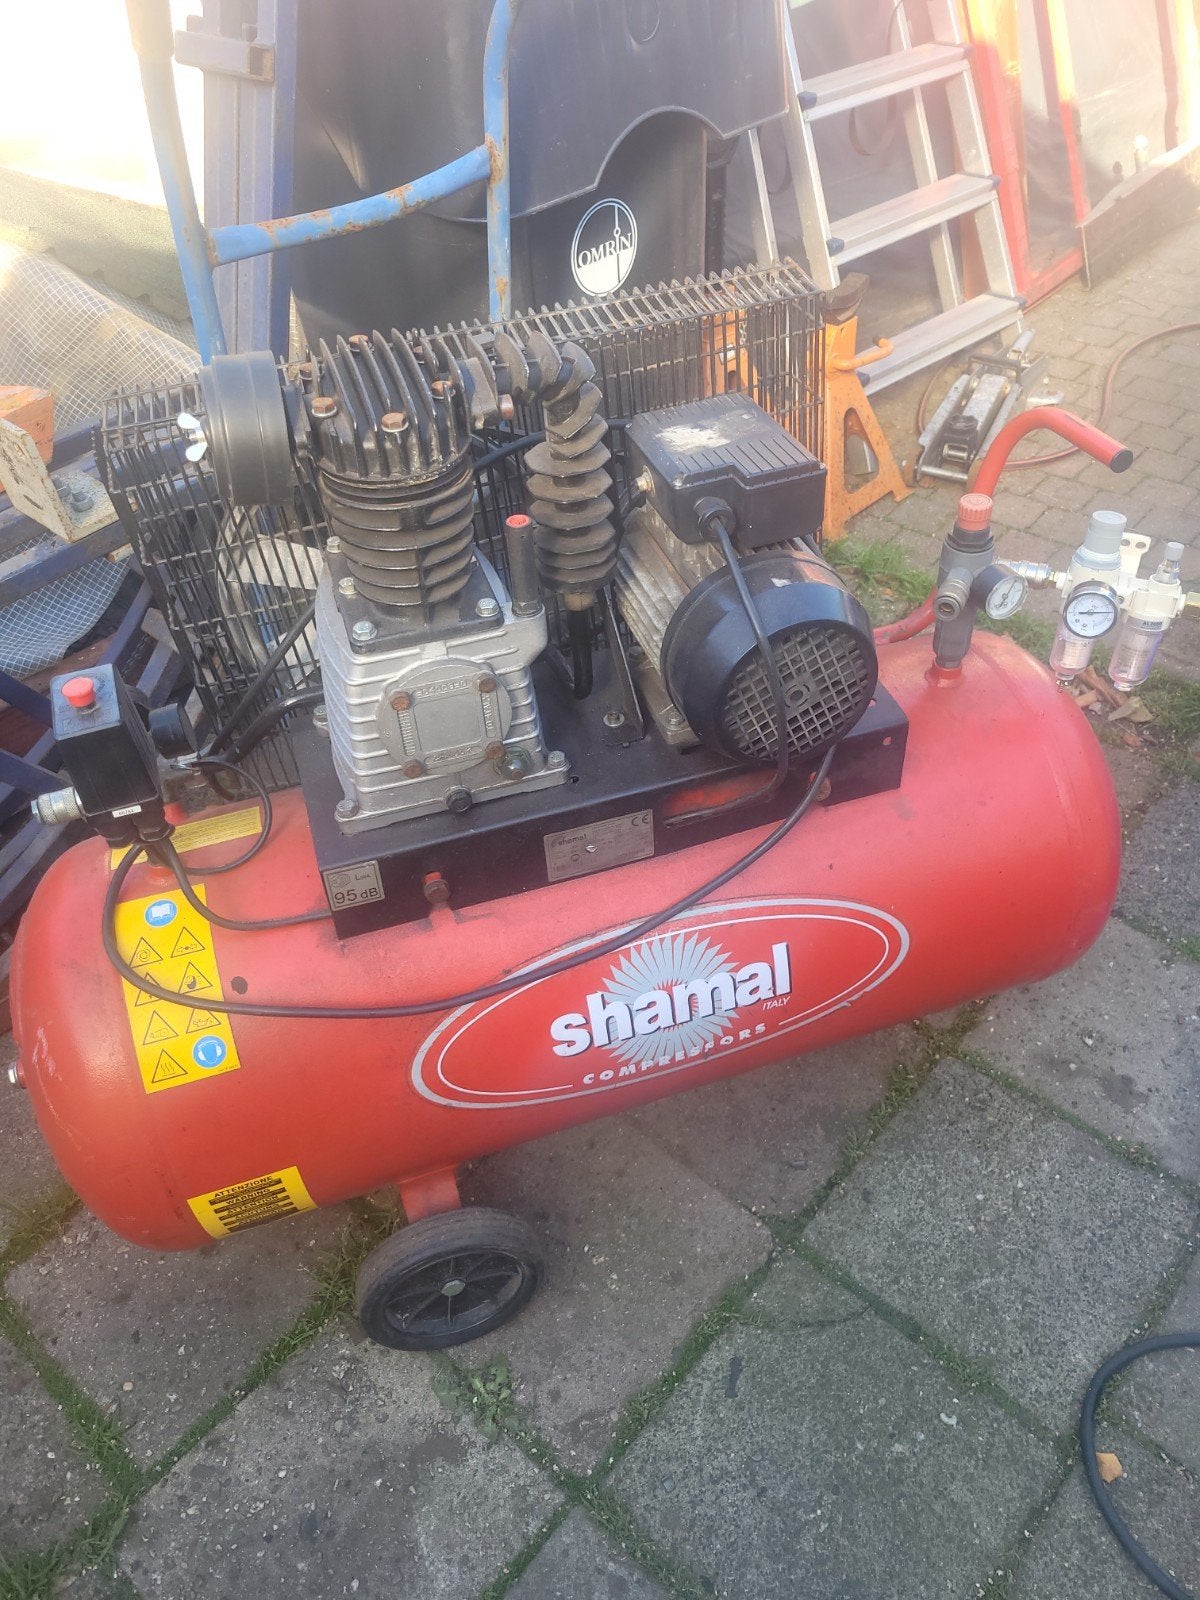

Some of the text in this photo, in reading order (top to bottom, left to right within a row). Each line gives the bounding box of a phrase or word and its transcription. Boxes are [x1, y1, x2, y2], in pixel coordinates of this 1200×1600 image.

[578, 232, 632, 267] OMRIN
[334, 887, 379, 904] 95 dB
[550, 942, 792, 1057] shamal
[762, 996, 791, 1011] ITALY
[214, 1176, 273, 1198] ATTENZIONE
[226, 1189, 271, 1205] WARNING
